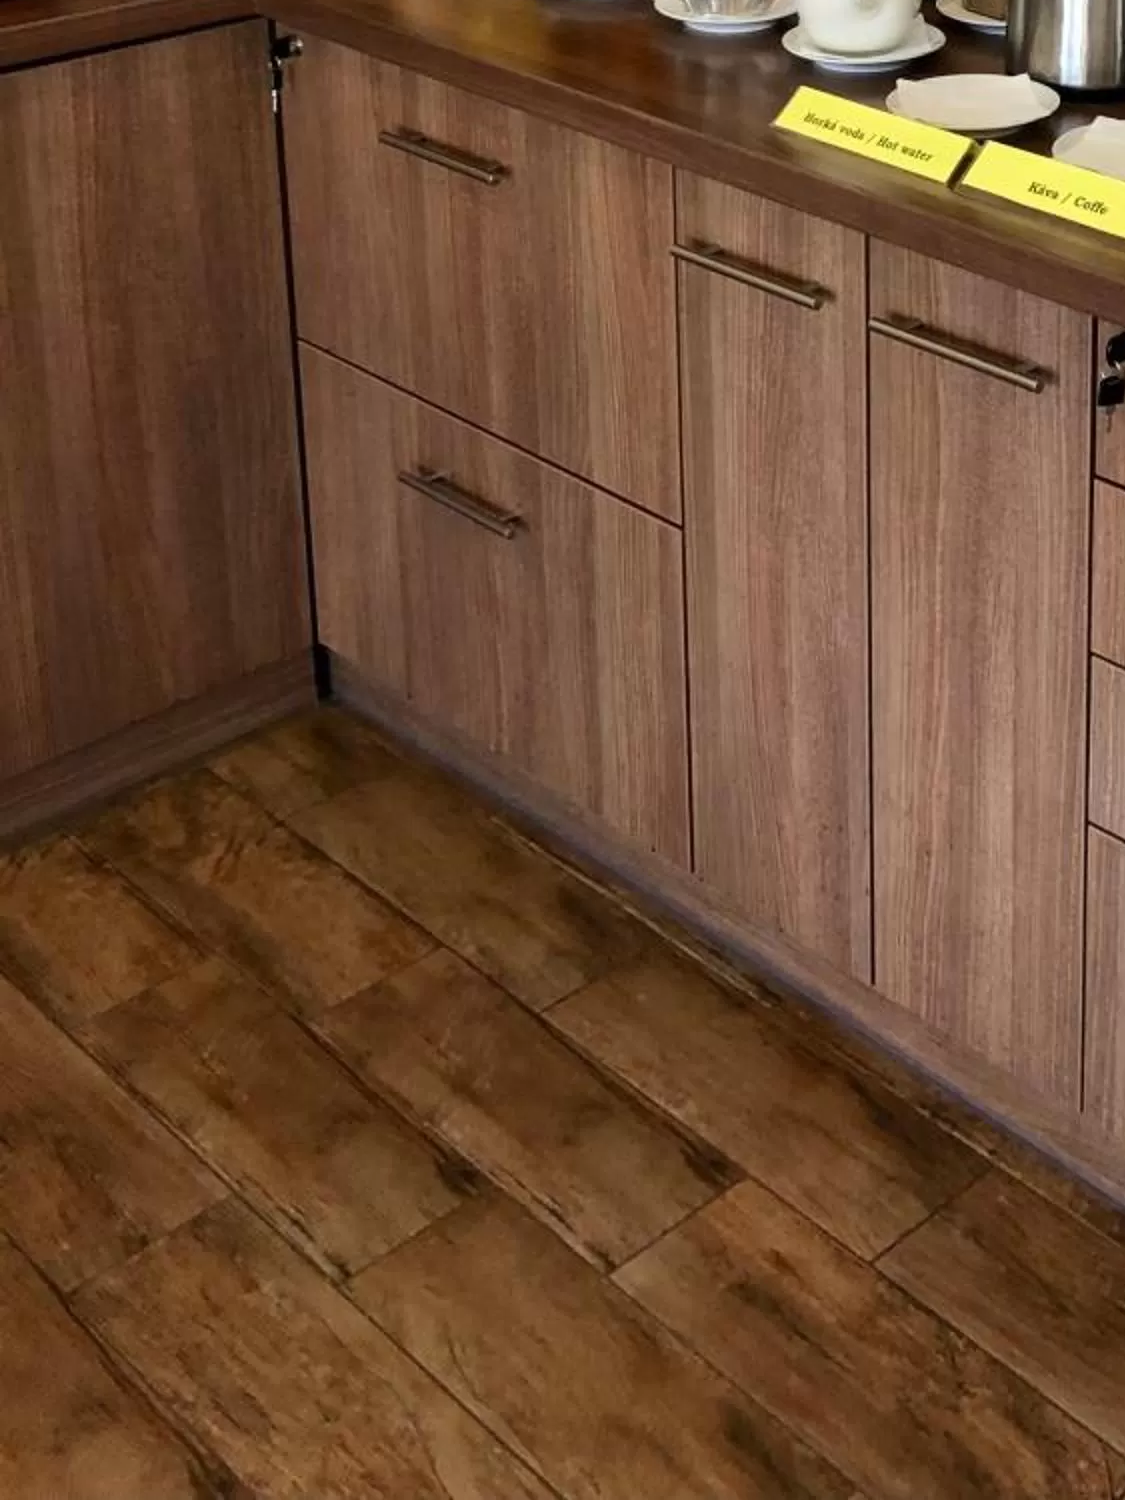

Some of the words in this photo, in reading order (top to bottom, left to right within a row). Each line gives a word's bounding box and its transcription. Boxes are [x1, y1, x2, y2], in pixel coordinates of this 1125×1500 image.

[840, 125, 865, 140] voda
[876, 135, 899, 151] Hot
[900, 145, 934, 161] water
[1028, 181, 1059, 200] Káva
[1074, 195, 1109, 215] Coffe
